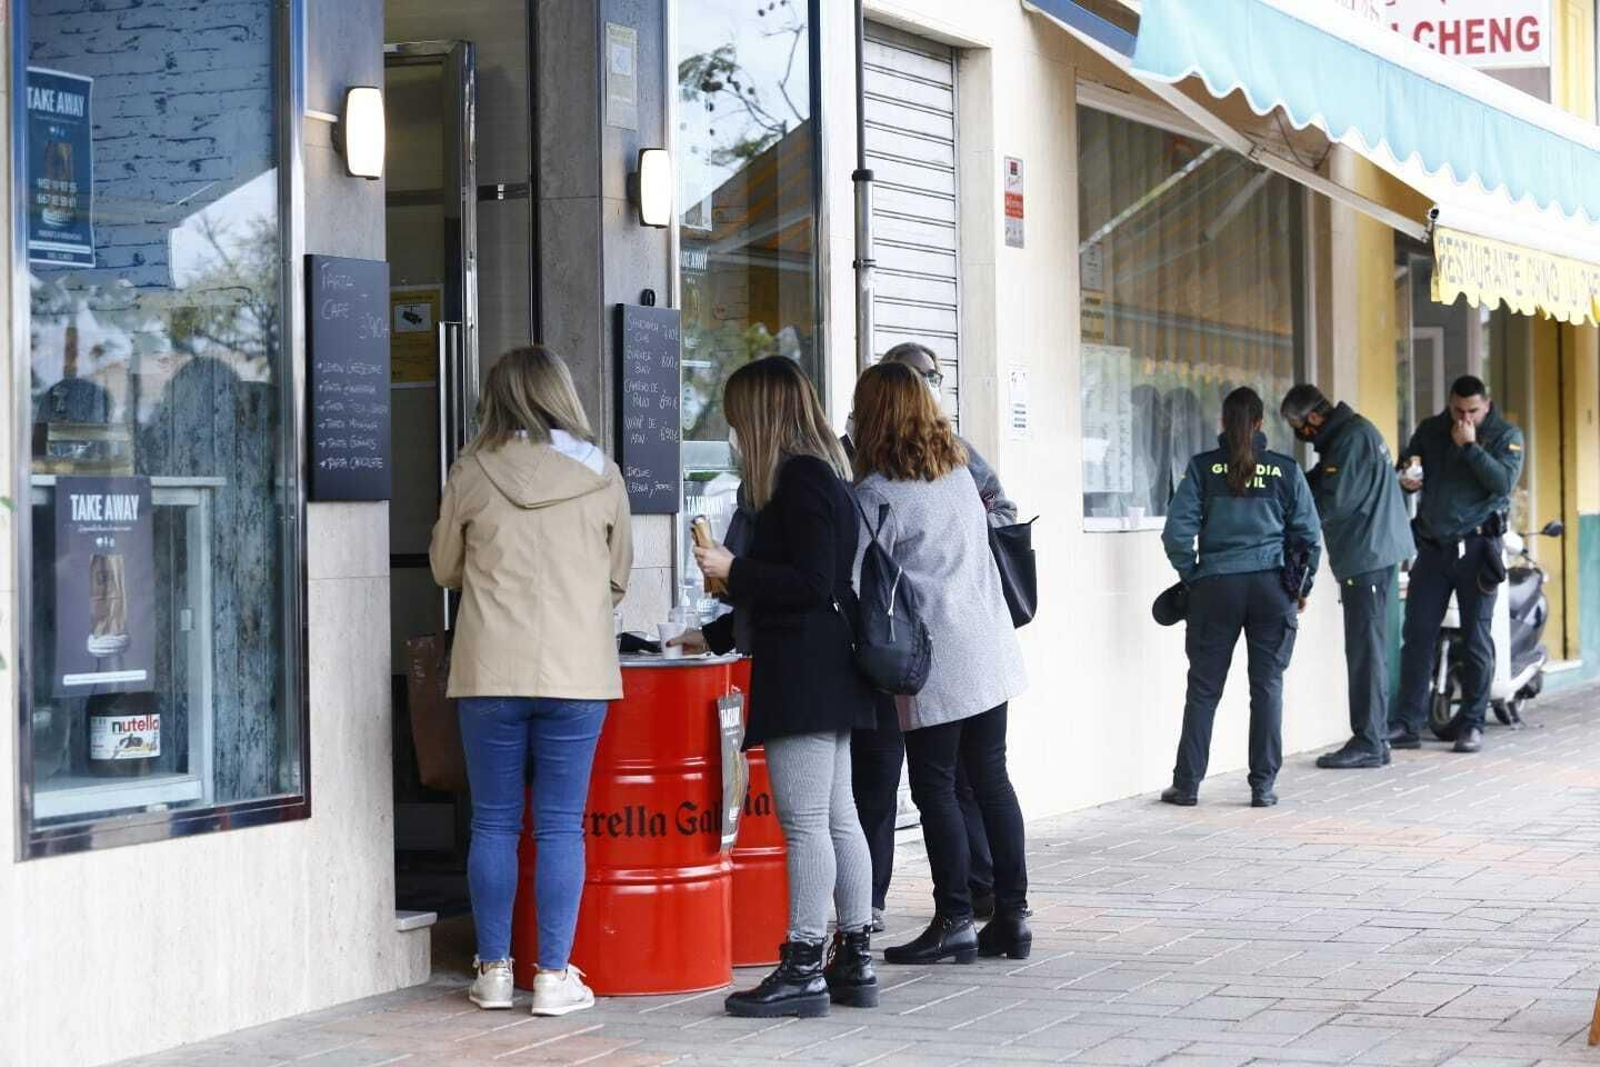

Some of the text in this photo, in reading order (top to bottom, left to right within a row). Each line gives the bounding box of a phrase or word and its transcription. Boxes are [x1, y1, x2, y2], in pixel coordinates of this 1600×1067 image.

[1414, 16, 1540, 55] CHENG
[27, 86, 85, 118] TAKE AWAY
[1211, 463, 1283, 479] GDIA
[70, 494, 140, 521] TAKE AWAY
[112, 713, 160, 736] nutella
